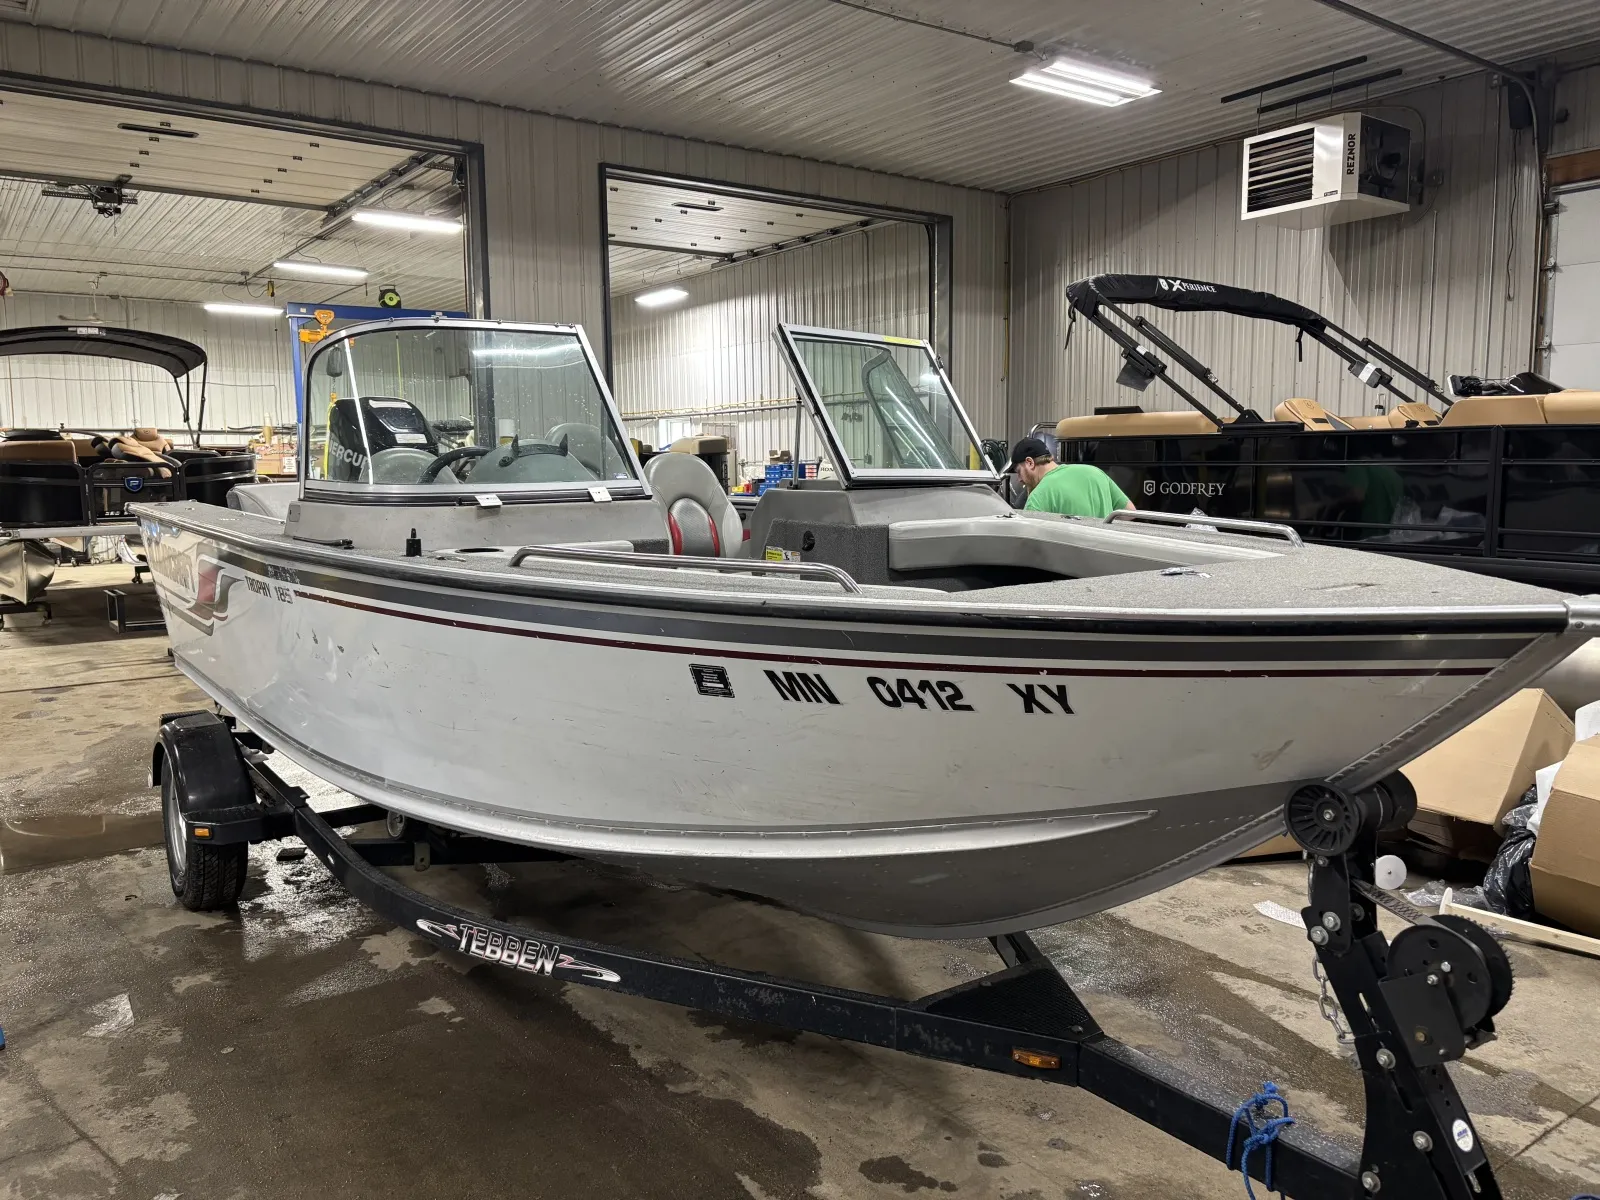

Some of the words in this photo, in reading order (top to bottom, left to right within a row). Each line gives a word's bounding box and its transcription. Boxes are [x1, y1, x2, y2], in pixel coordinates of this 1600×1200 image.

[1346, 133, 1356, 175] REZNOR
[1166, 279, 1217, 293] XPERIENCE
[1160, 482, 1226, 498] GODFREY
[245, 576, 272, 599] TROPHY
[274, 586, 294, 605] 185
[763, 669, 841, 705] MN
[866, 676, 975, 712] 0412
[1006, 683, 1075, 715] XY
[459, 923, 560, 976] TEBBEN
